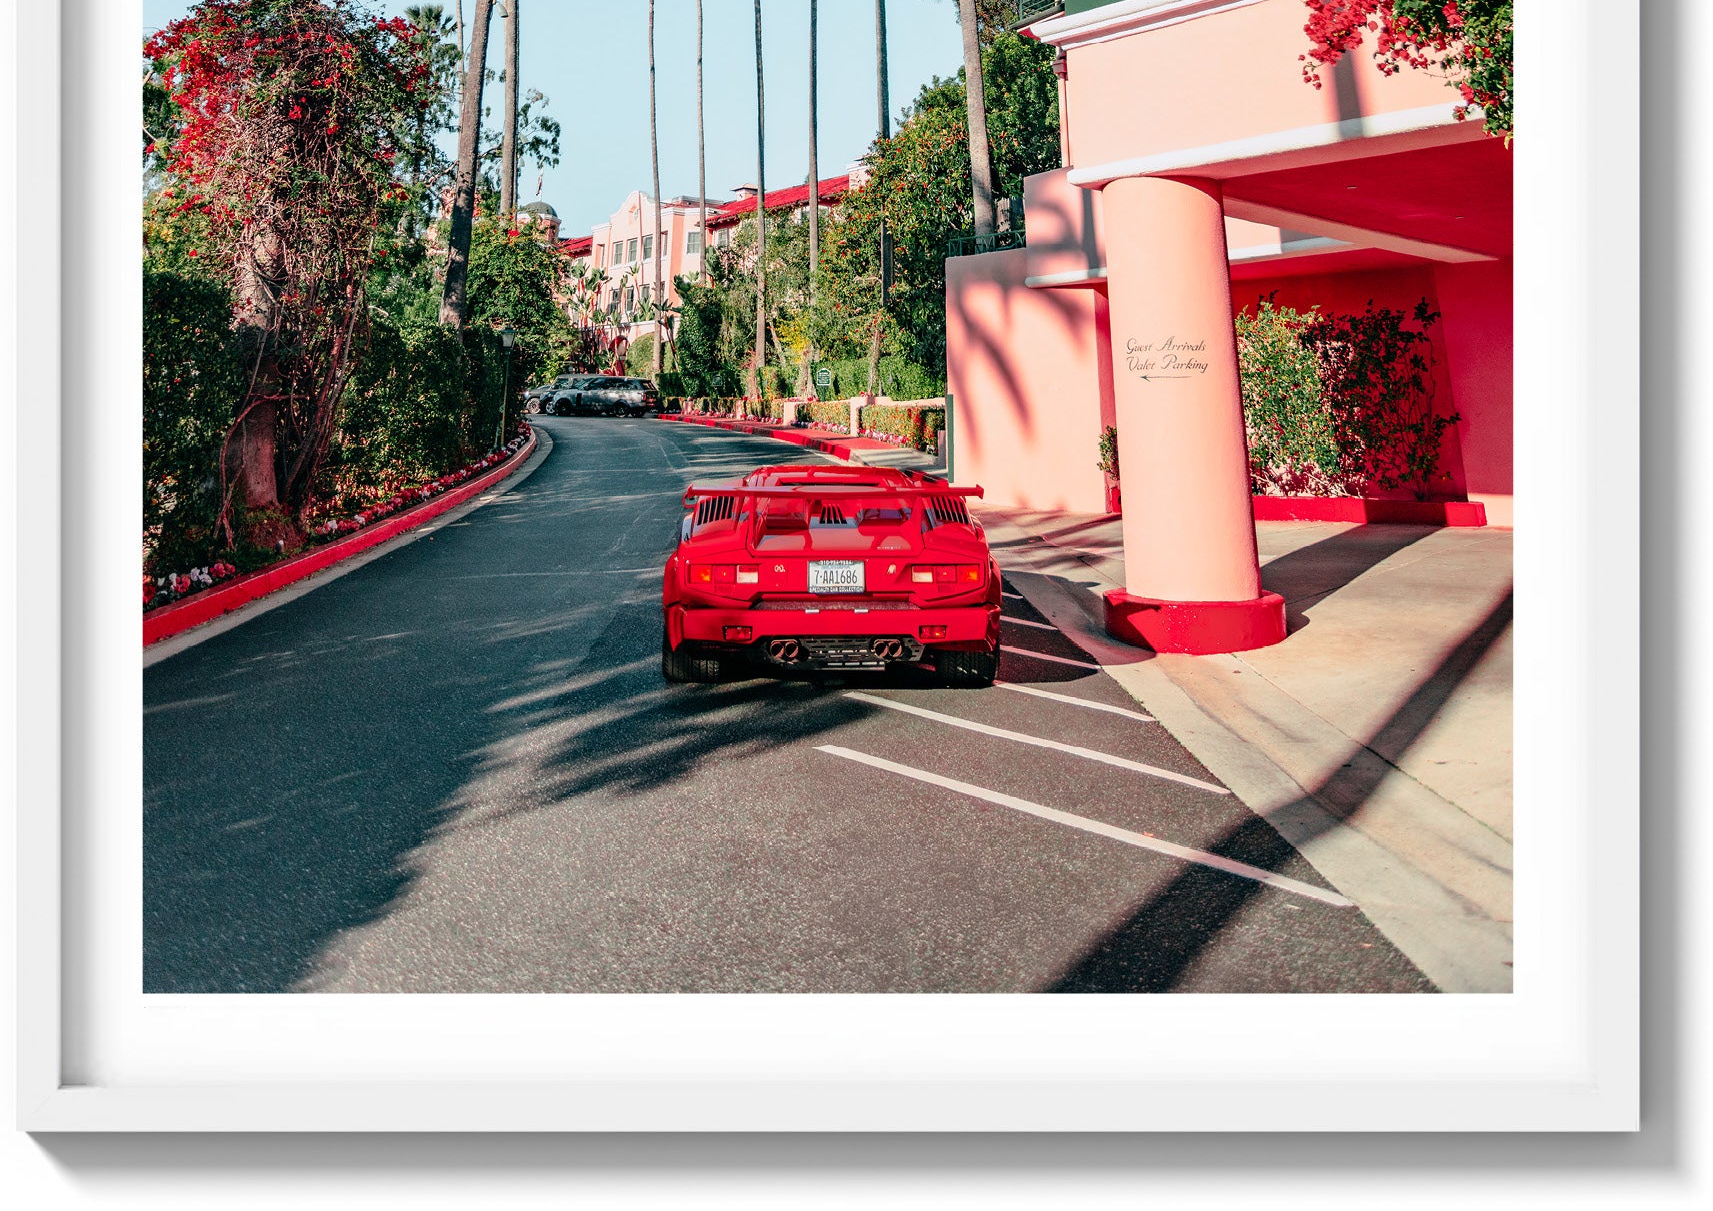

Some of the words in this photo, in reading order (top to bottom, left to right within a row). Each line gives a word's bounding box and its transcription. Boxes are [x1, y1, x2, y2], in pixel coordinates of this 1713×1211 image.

[1126, 337, 1153, 355] Guest
[1156, 335, 1207, 352] Arrivals
[1126, 355, 1156, 372] Valet
[1161, 353, 1209, 374] Parking
